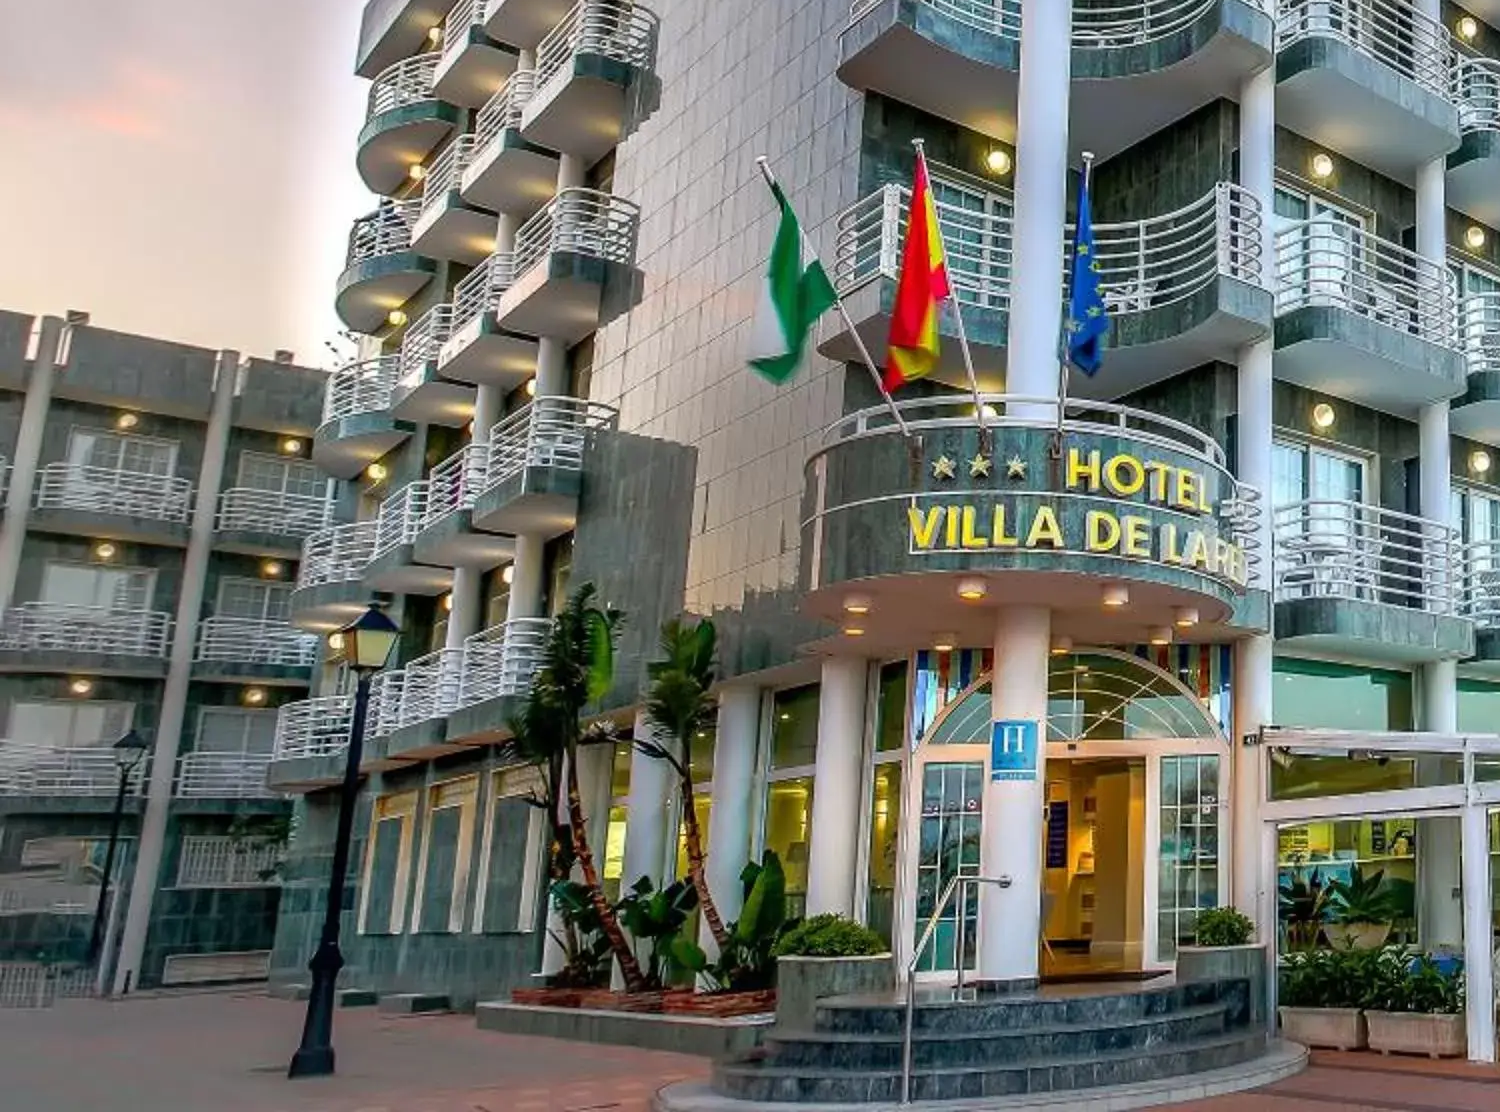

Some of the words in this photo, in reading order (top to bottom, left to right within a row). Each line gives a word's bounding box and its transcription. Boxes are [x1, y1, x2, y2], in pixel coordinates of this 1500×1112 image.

[1067, 448, 1213, 514] HOTEL
[908, 504, 1064, 549] VILLA
[1087, 511, 1151, 557] DE
